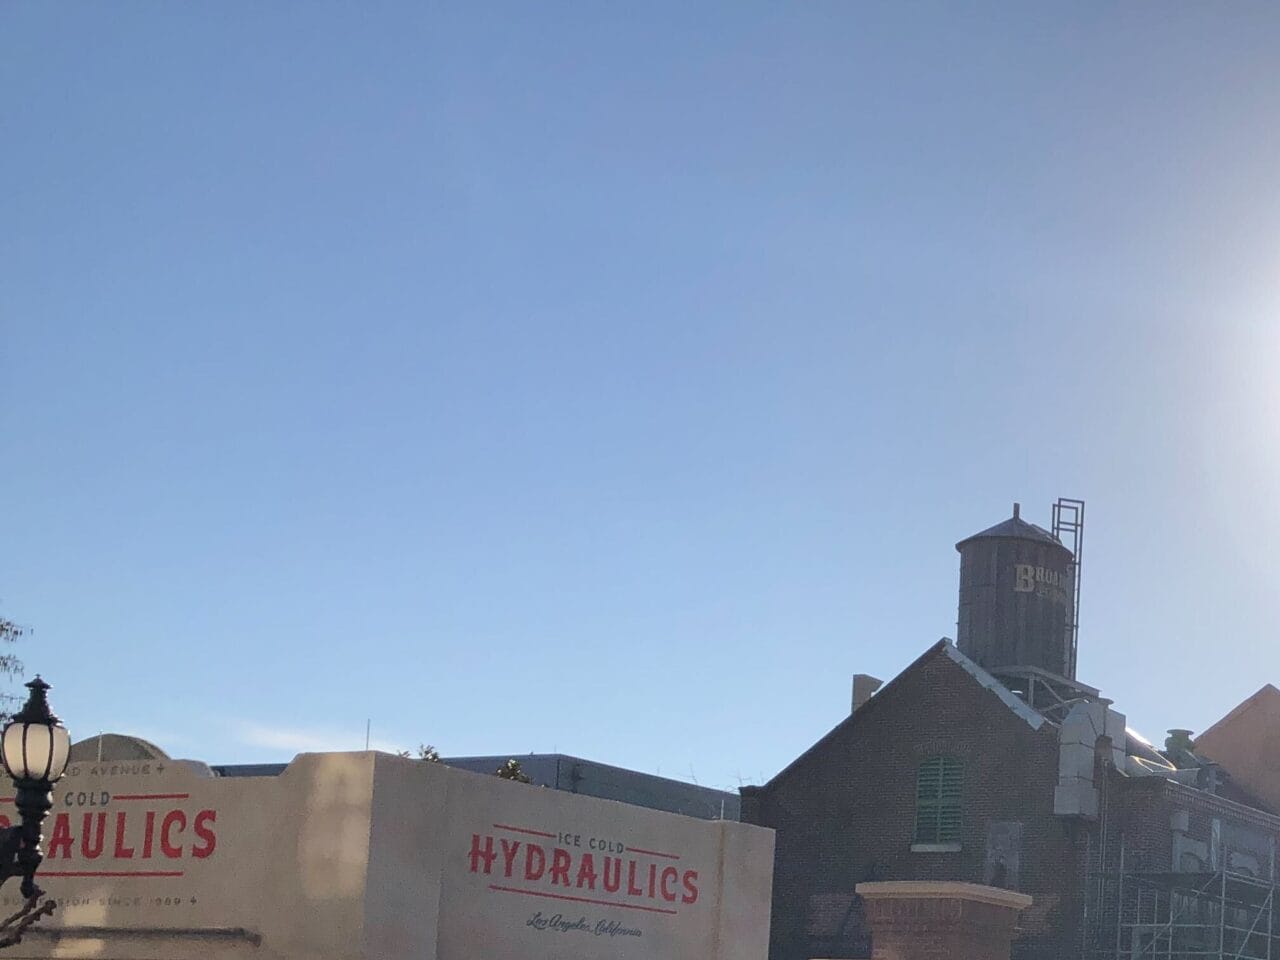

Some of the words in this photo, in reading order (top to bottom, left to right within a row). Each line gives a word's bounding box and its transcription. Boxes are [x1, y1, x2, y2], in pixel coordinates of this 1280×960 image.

[65, 791, 110, 806] COLD
[0, 810, 217, 859] AULICS
[558, 832, 581, 847] ICE
[589, 838, 624, 853] COLD
[468, 833, 699, 904] HYDRAULICS
[526, 911, 547, 930] Los
[594, 919, 642, 936] California
